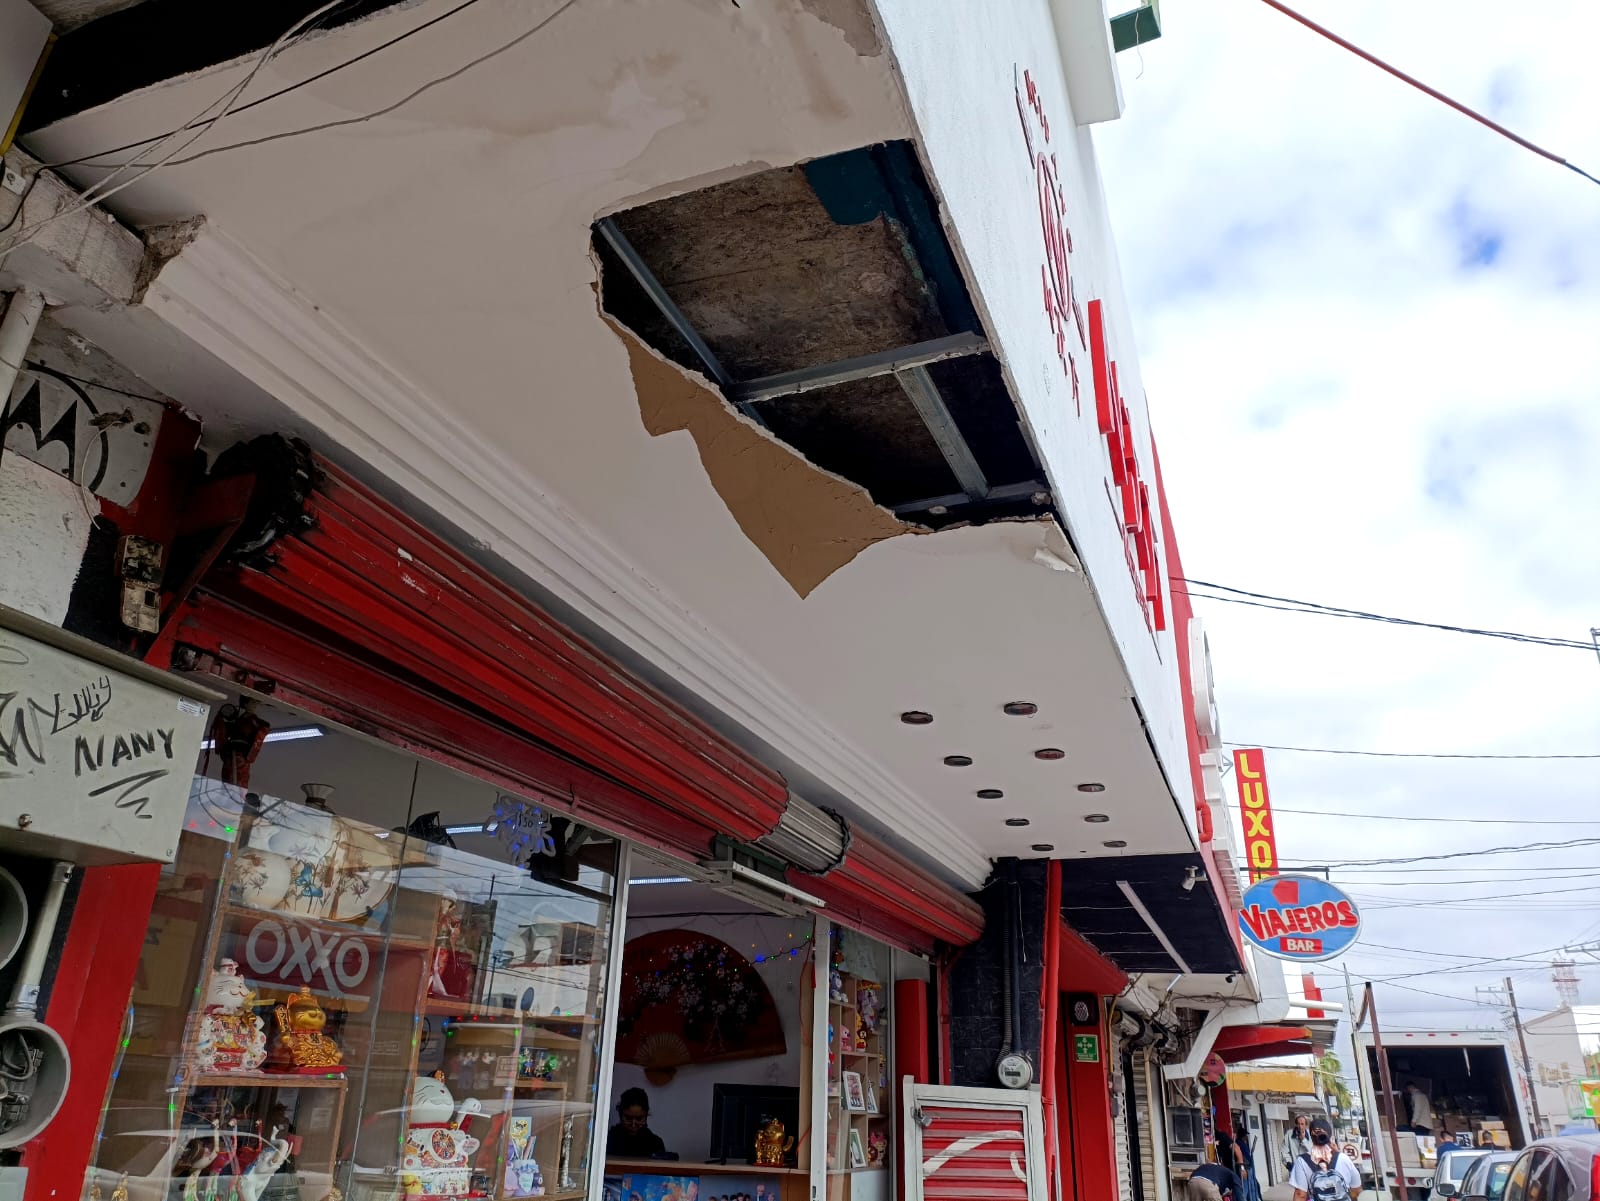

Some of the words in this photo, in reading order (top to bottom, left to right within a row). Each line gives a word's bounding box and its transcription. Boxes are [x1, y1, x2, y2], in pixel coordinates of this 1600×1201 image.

[75, 728, 175, 777] NANY
[1240, 900, 1360, 940] VIAJEROS
[1286, 938, 1315, 952] BAR
